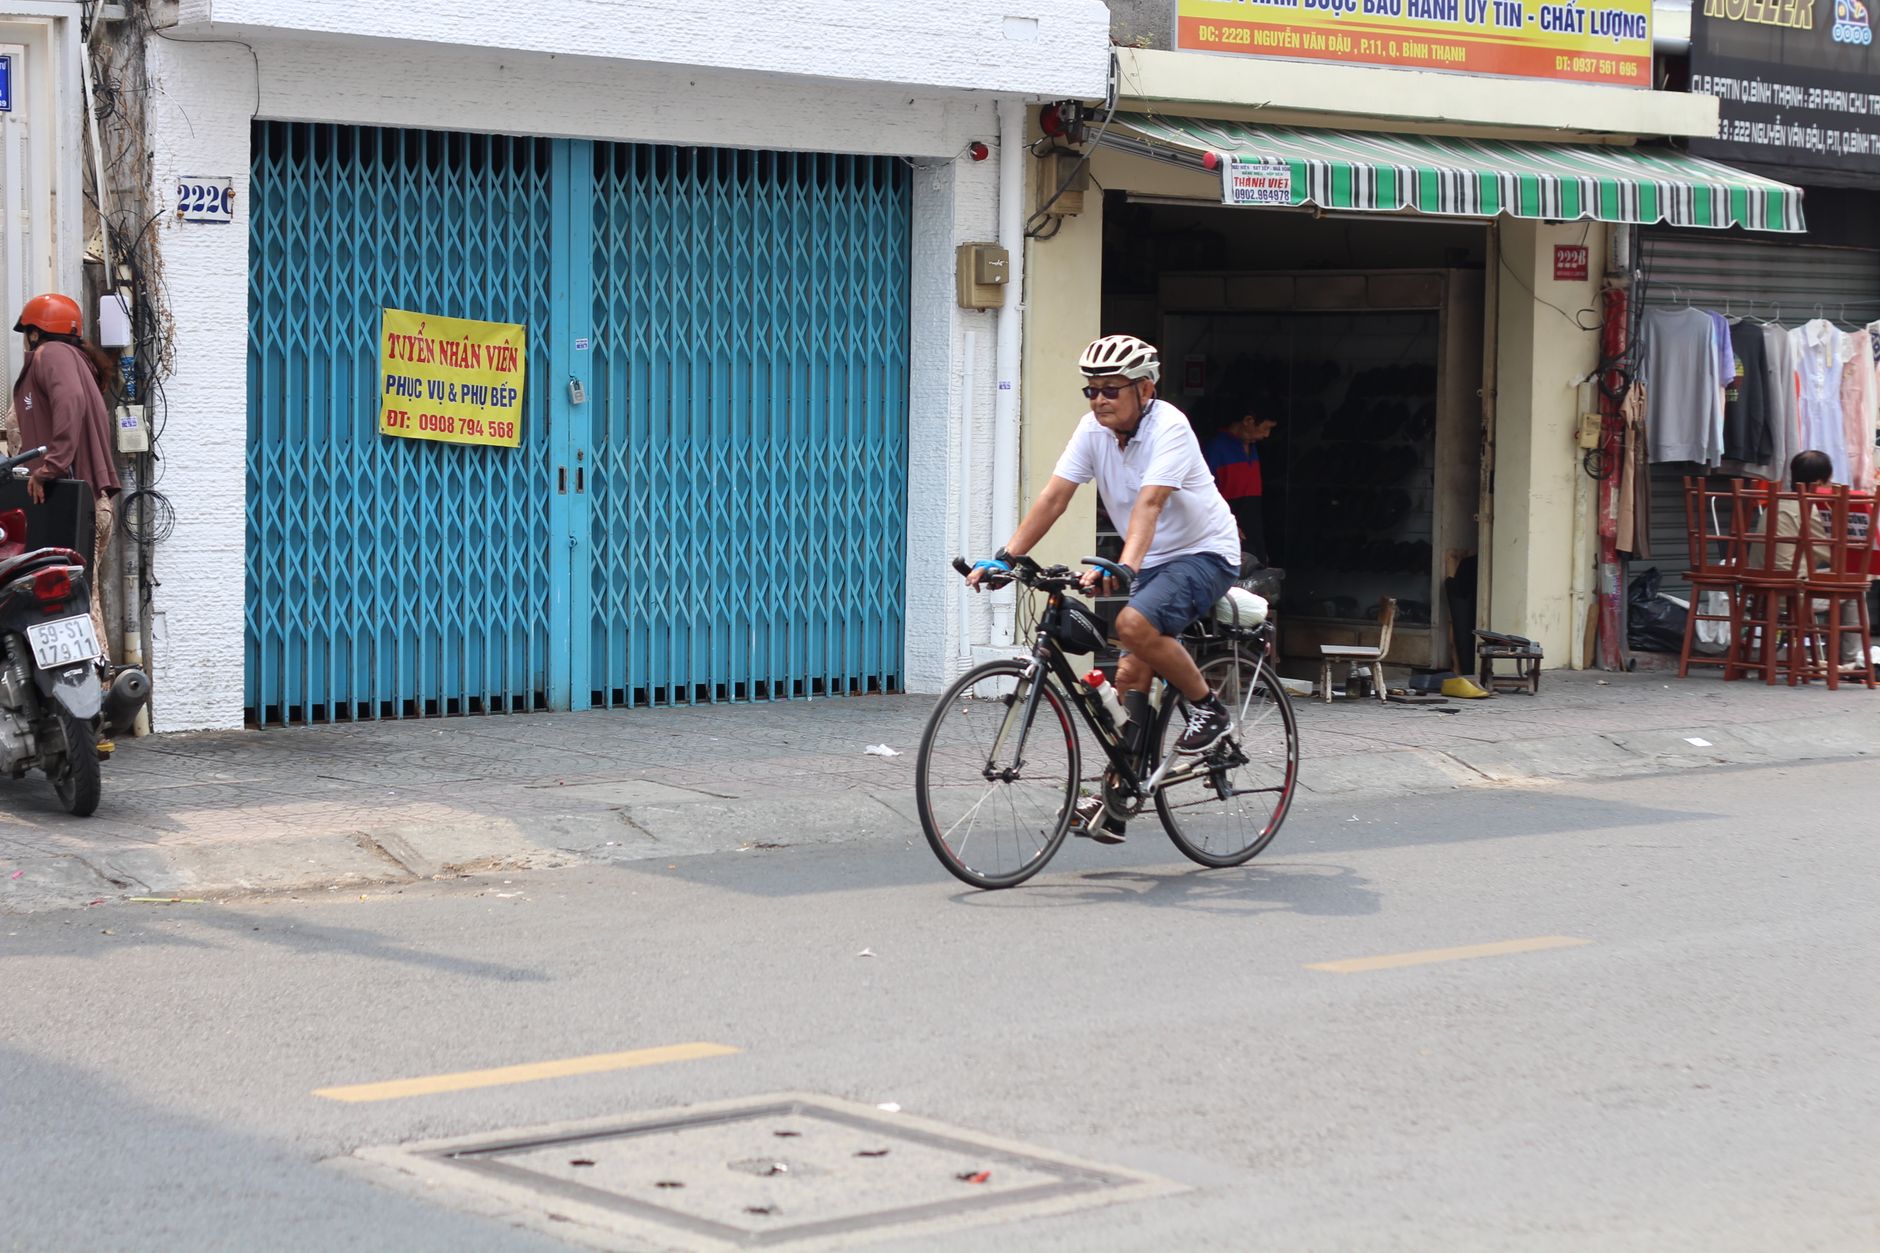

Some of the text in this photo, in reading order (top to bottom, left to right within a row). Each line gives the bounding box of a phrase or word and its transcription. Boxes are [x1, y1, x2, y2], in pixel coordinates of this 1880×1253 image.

[1540, 0, 1585, 33] CHẤT
[1590, 9, 1647, 42] LƯỢNG
[1199, 25, 1219, 42] ĐC:
[1222, 27, 1251, 44] 222B
[1254, 26, 1300, 49] NGUYỄN
[1303, 31, 1326, 50] VĂN
[1360, 38, 1386, 57] P.11,
[1389, 41, 1400, 57] Q.
[1402, 39, 1429, 59] BÌNH
[1431, 44, 1466, 64] THẠNH
[1556, 55, 1638, 77] ĐT: 0937 561 695
[1713, 76, 1740, 100] PATIN
[1808, 87, 1821, 109] 2A
[1823, 88, 1848, 112] PHAN
[1849, 91, 1867, 114] CHU
[1722, 119, 1729, 140] 3
[1733, 120, 1751, 142] 222
[1235, 188, 1290, 201] 0902.964978
[388, 321, 519, 373] TUYỂN NHÂN VIÊN
[385, 374, 518, 410] PHỤC VỤ & PHỤ BẾP
[386, 409, 514, 439] ĐT: 0908 794 568
